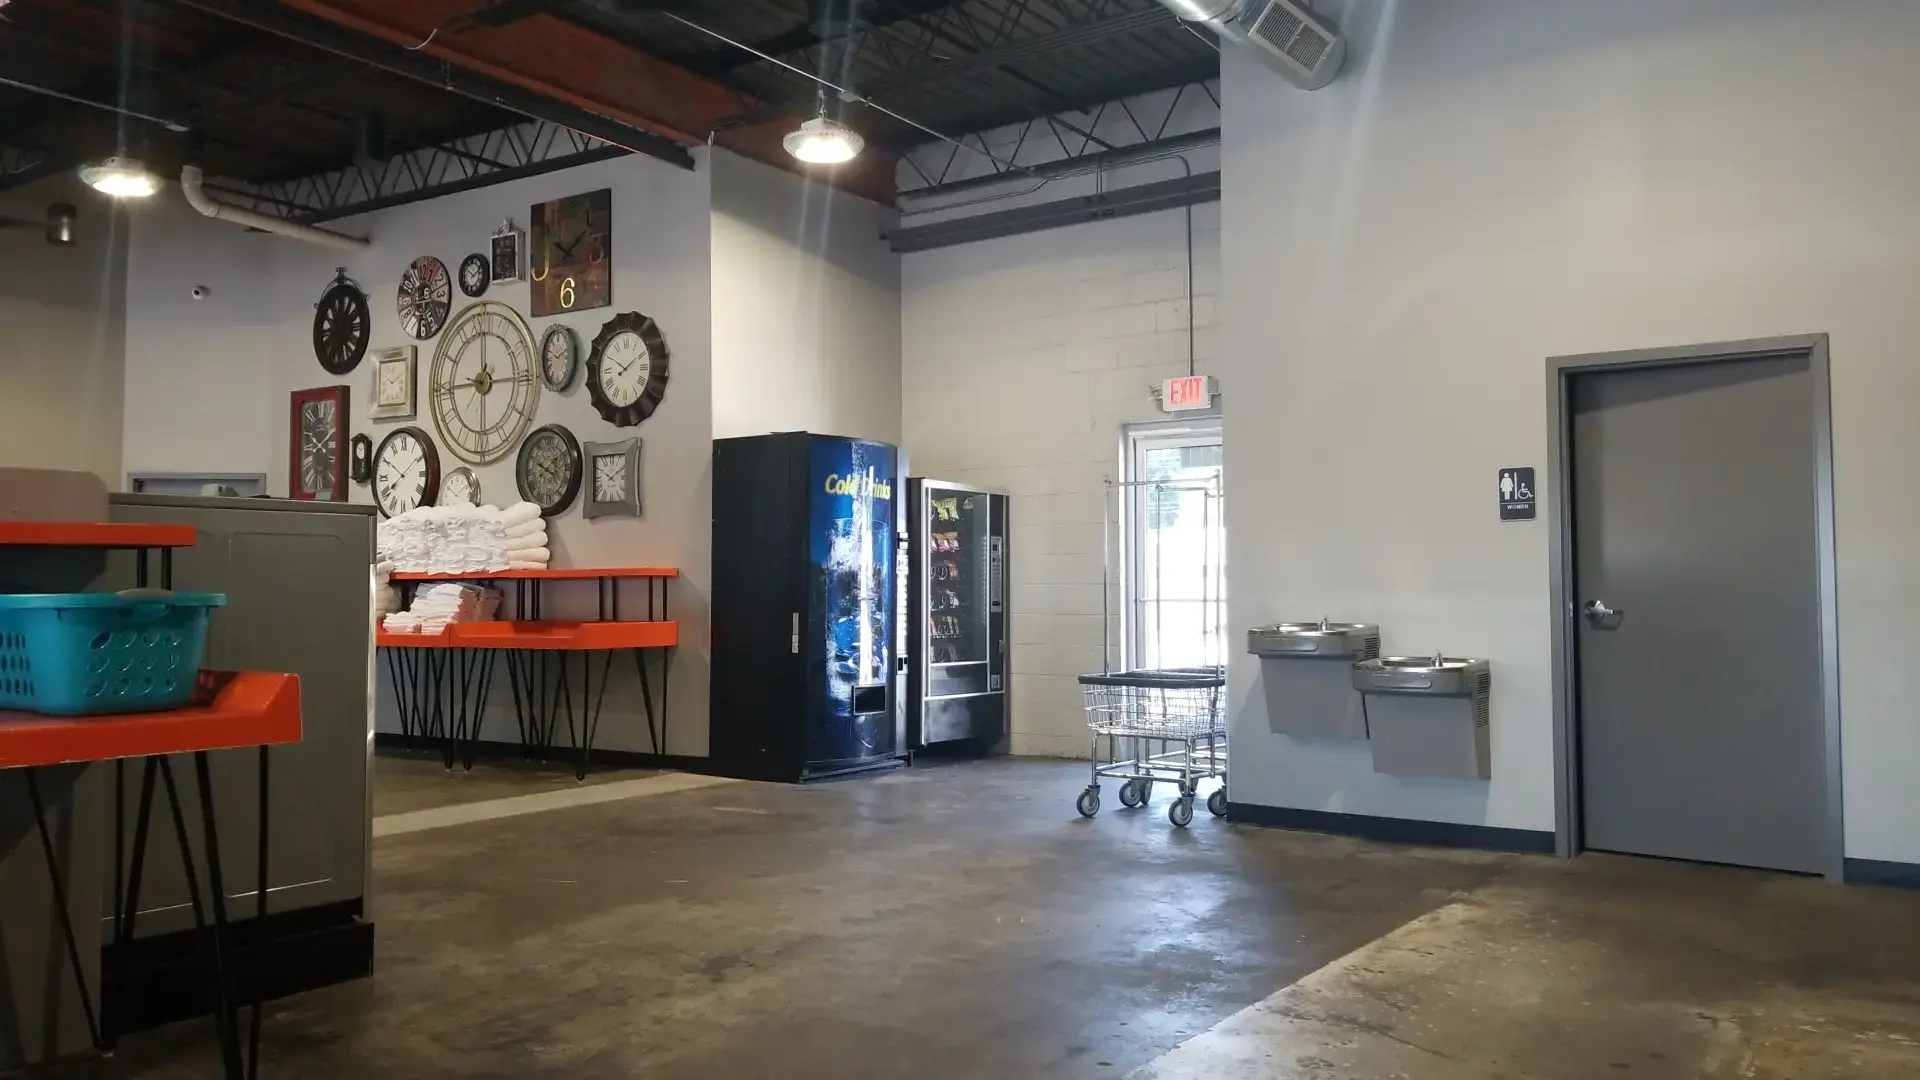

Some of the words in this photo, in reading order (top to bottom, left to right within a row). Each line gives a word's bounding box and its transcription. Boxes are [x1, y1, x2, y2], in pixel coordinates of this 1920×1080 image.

[560, 278, 575, 308] 6
[420, 320, 426, 337] 6
[1170, 377, 1202, 405] EXIT
[825, 474, 860, 496] Cold
